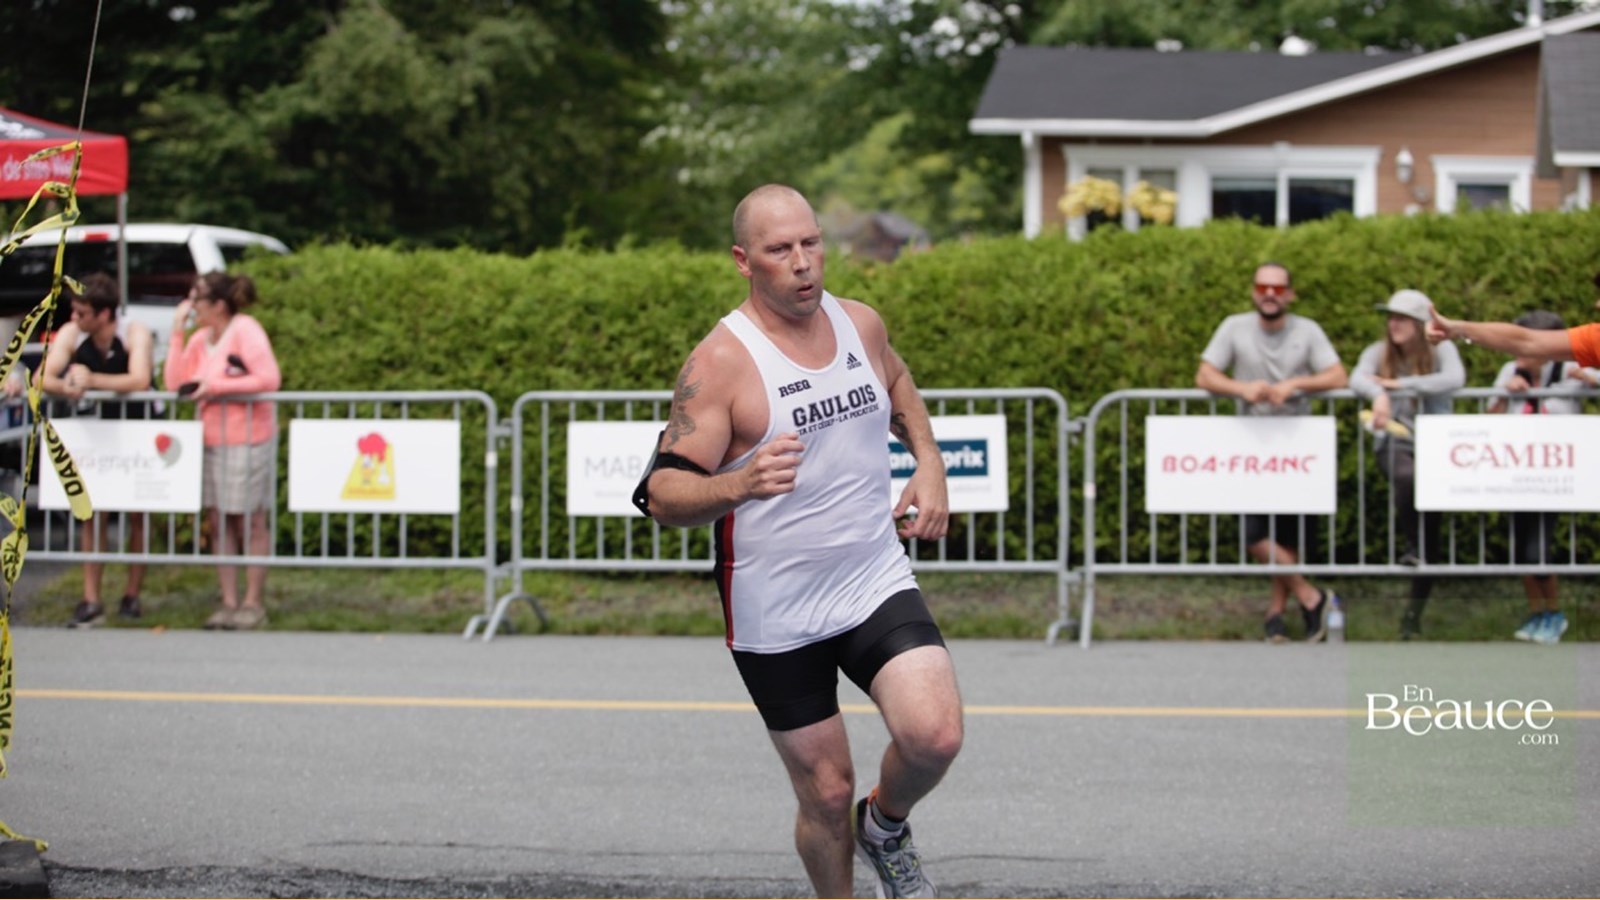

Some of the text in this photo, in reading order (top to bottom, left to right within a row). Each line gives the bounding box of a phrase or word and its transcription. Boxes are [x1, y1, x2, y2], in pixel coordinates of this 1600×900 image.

[778, 379, 812, 398] RSEQ
[792, 384, 877, 428] GAULOIS
[1449, 442, 1576, 470] CAMBI
